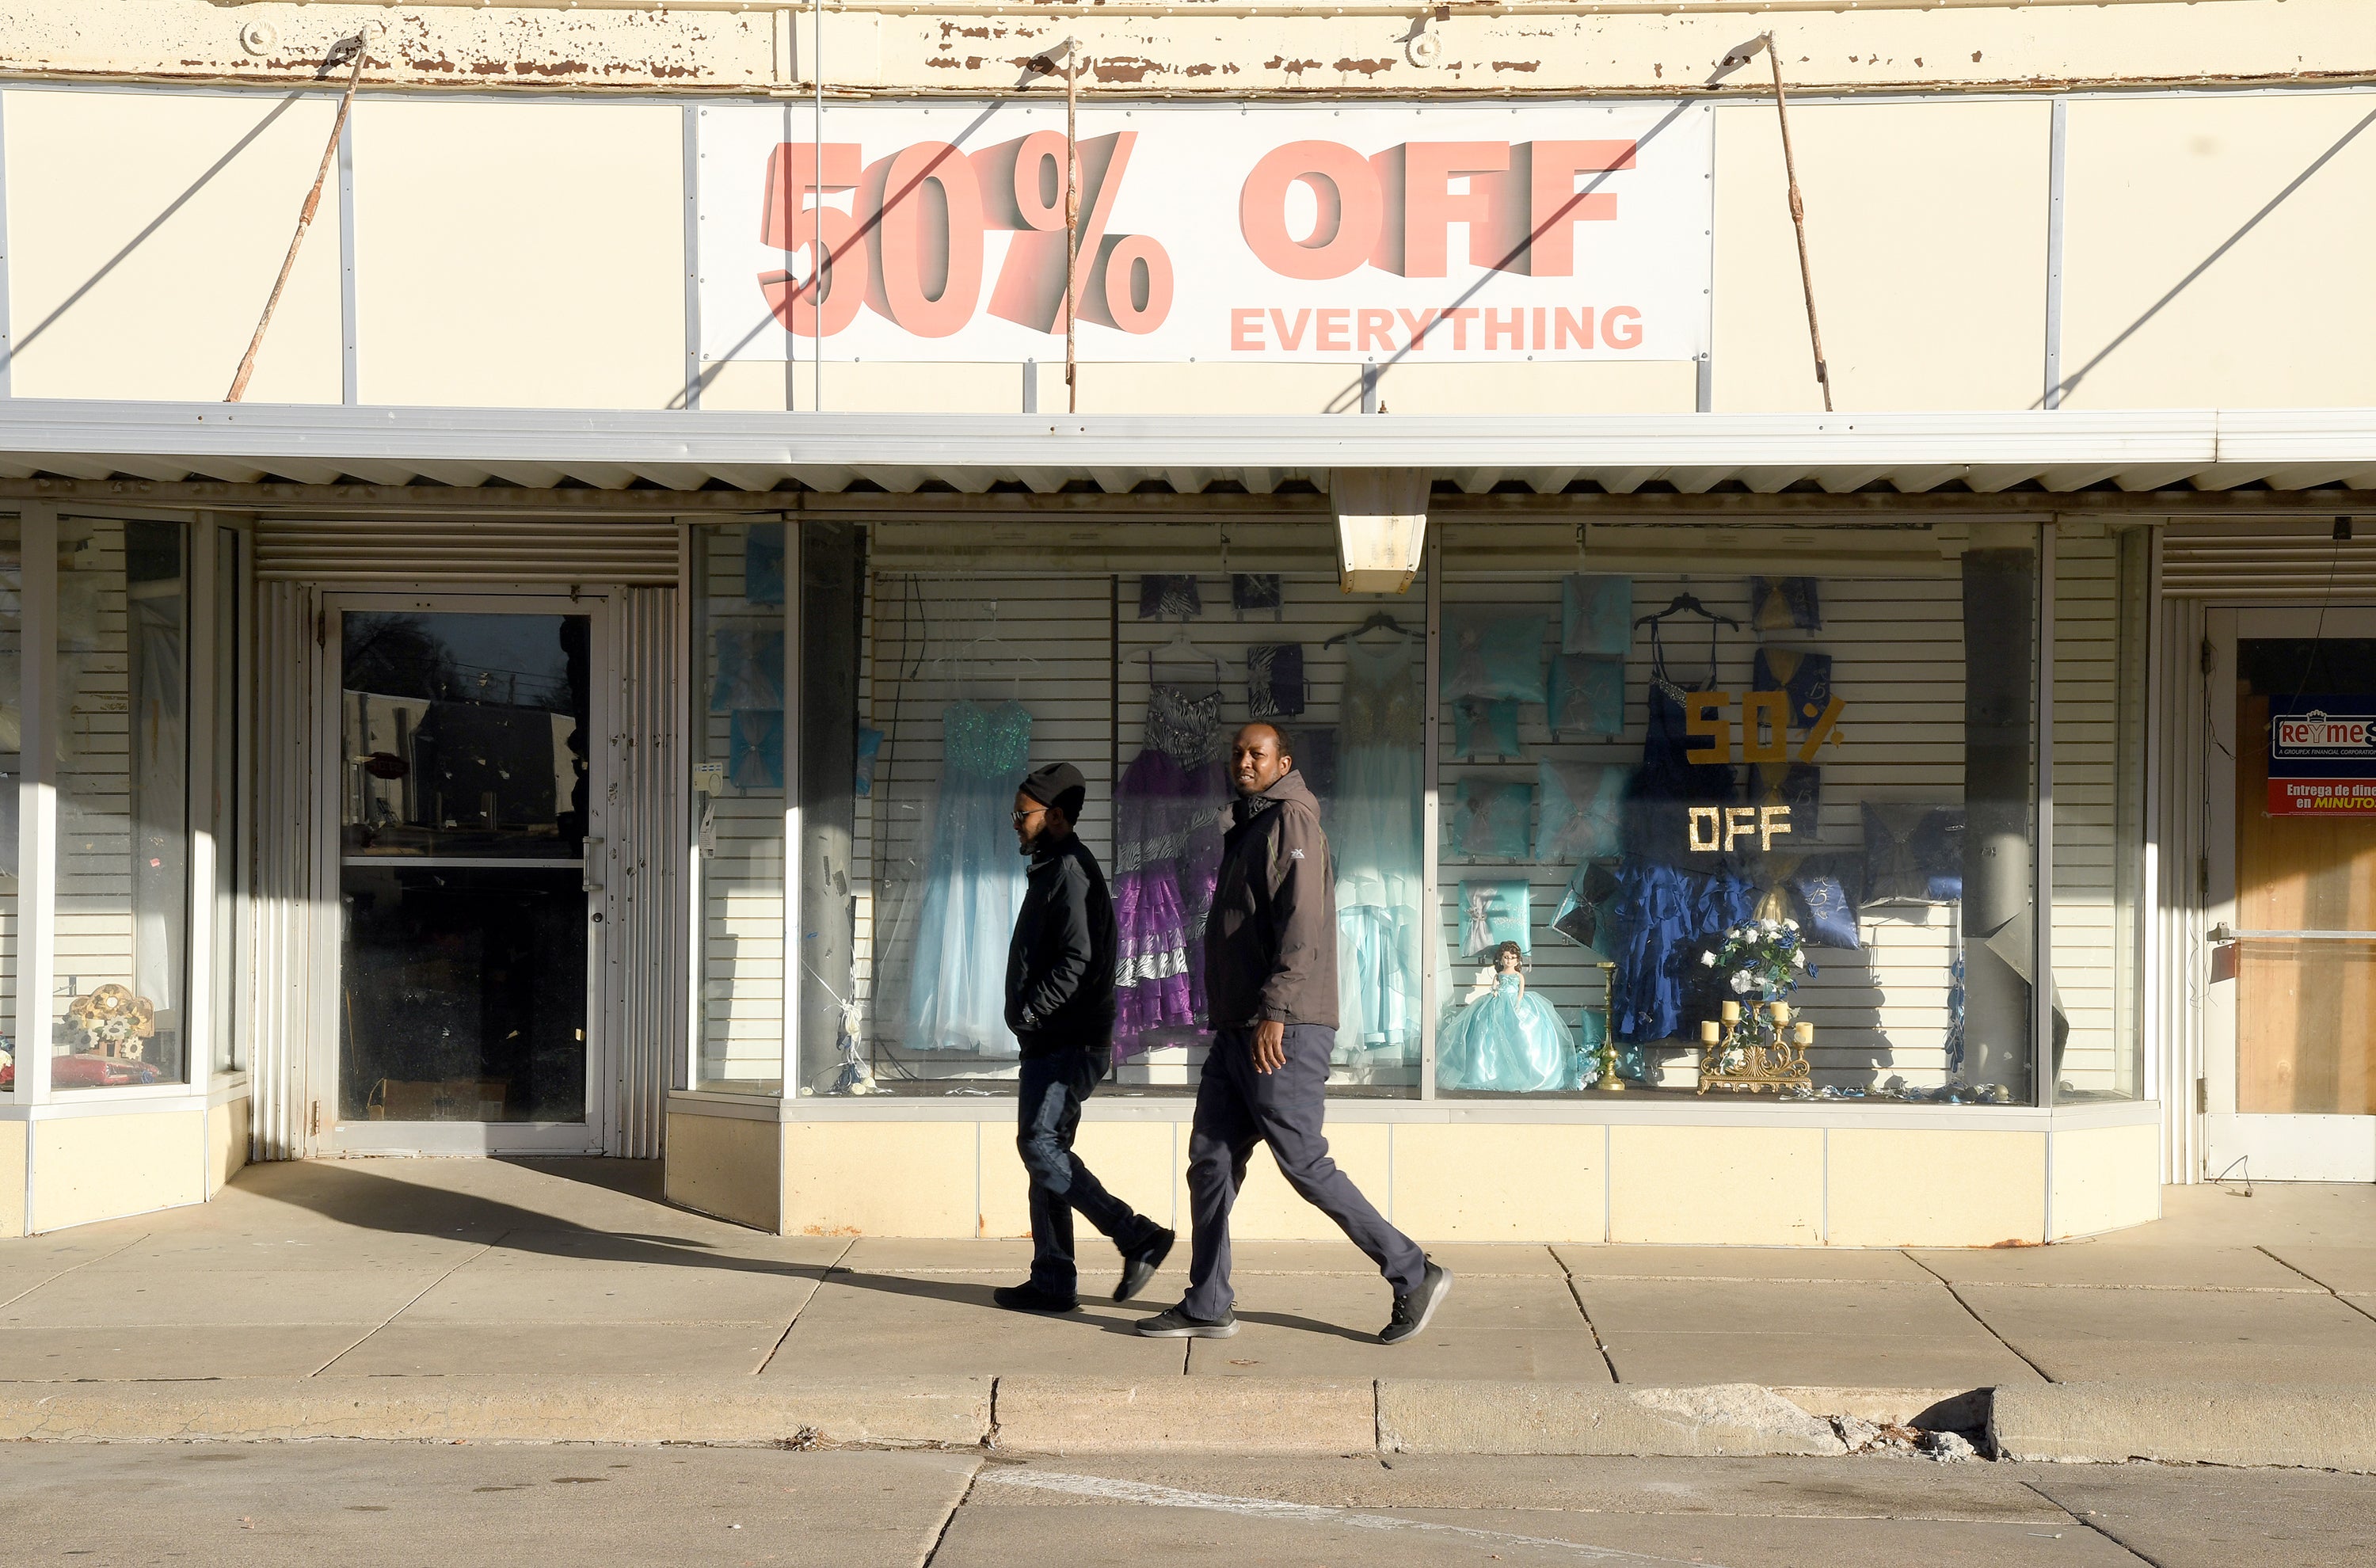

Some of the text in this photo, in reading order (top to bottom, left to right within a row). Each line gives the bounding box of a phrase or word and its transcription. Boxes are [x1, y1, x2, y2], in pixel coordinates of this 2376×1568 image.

[757, 130, 1636, 338] 50% OFF
[1231, 306, 1643, 351] EVERYTHING
[1804, 681, 1826, 700] 15
[1686, 691, 1846, 764] 50%
[2287, 784, 2332, 797] Entrega
[2335, 785, 2350, 796] de
[2296, 797, 2376, 809] en MINUTO
[1689, 805, 1792, 852] OFF
[1804, 887, 1828, 906] 15
